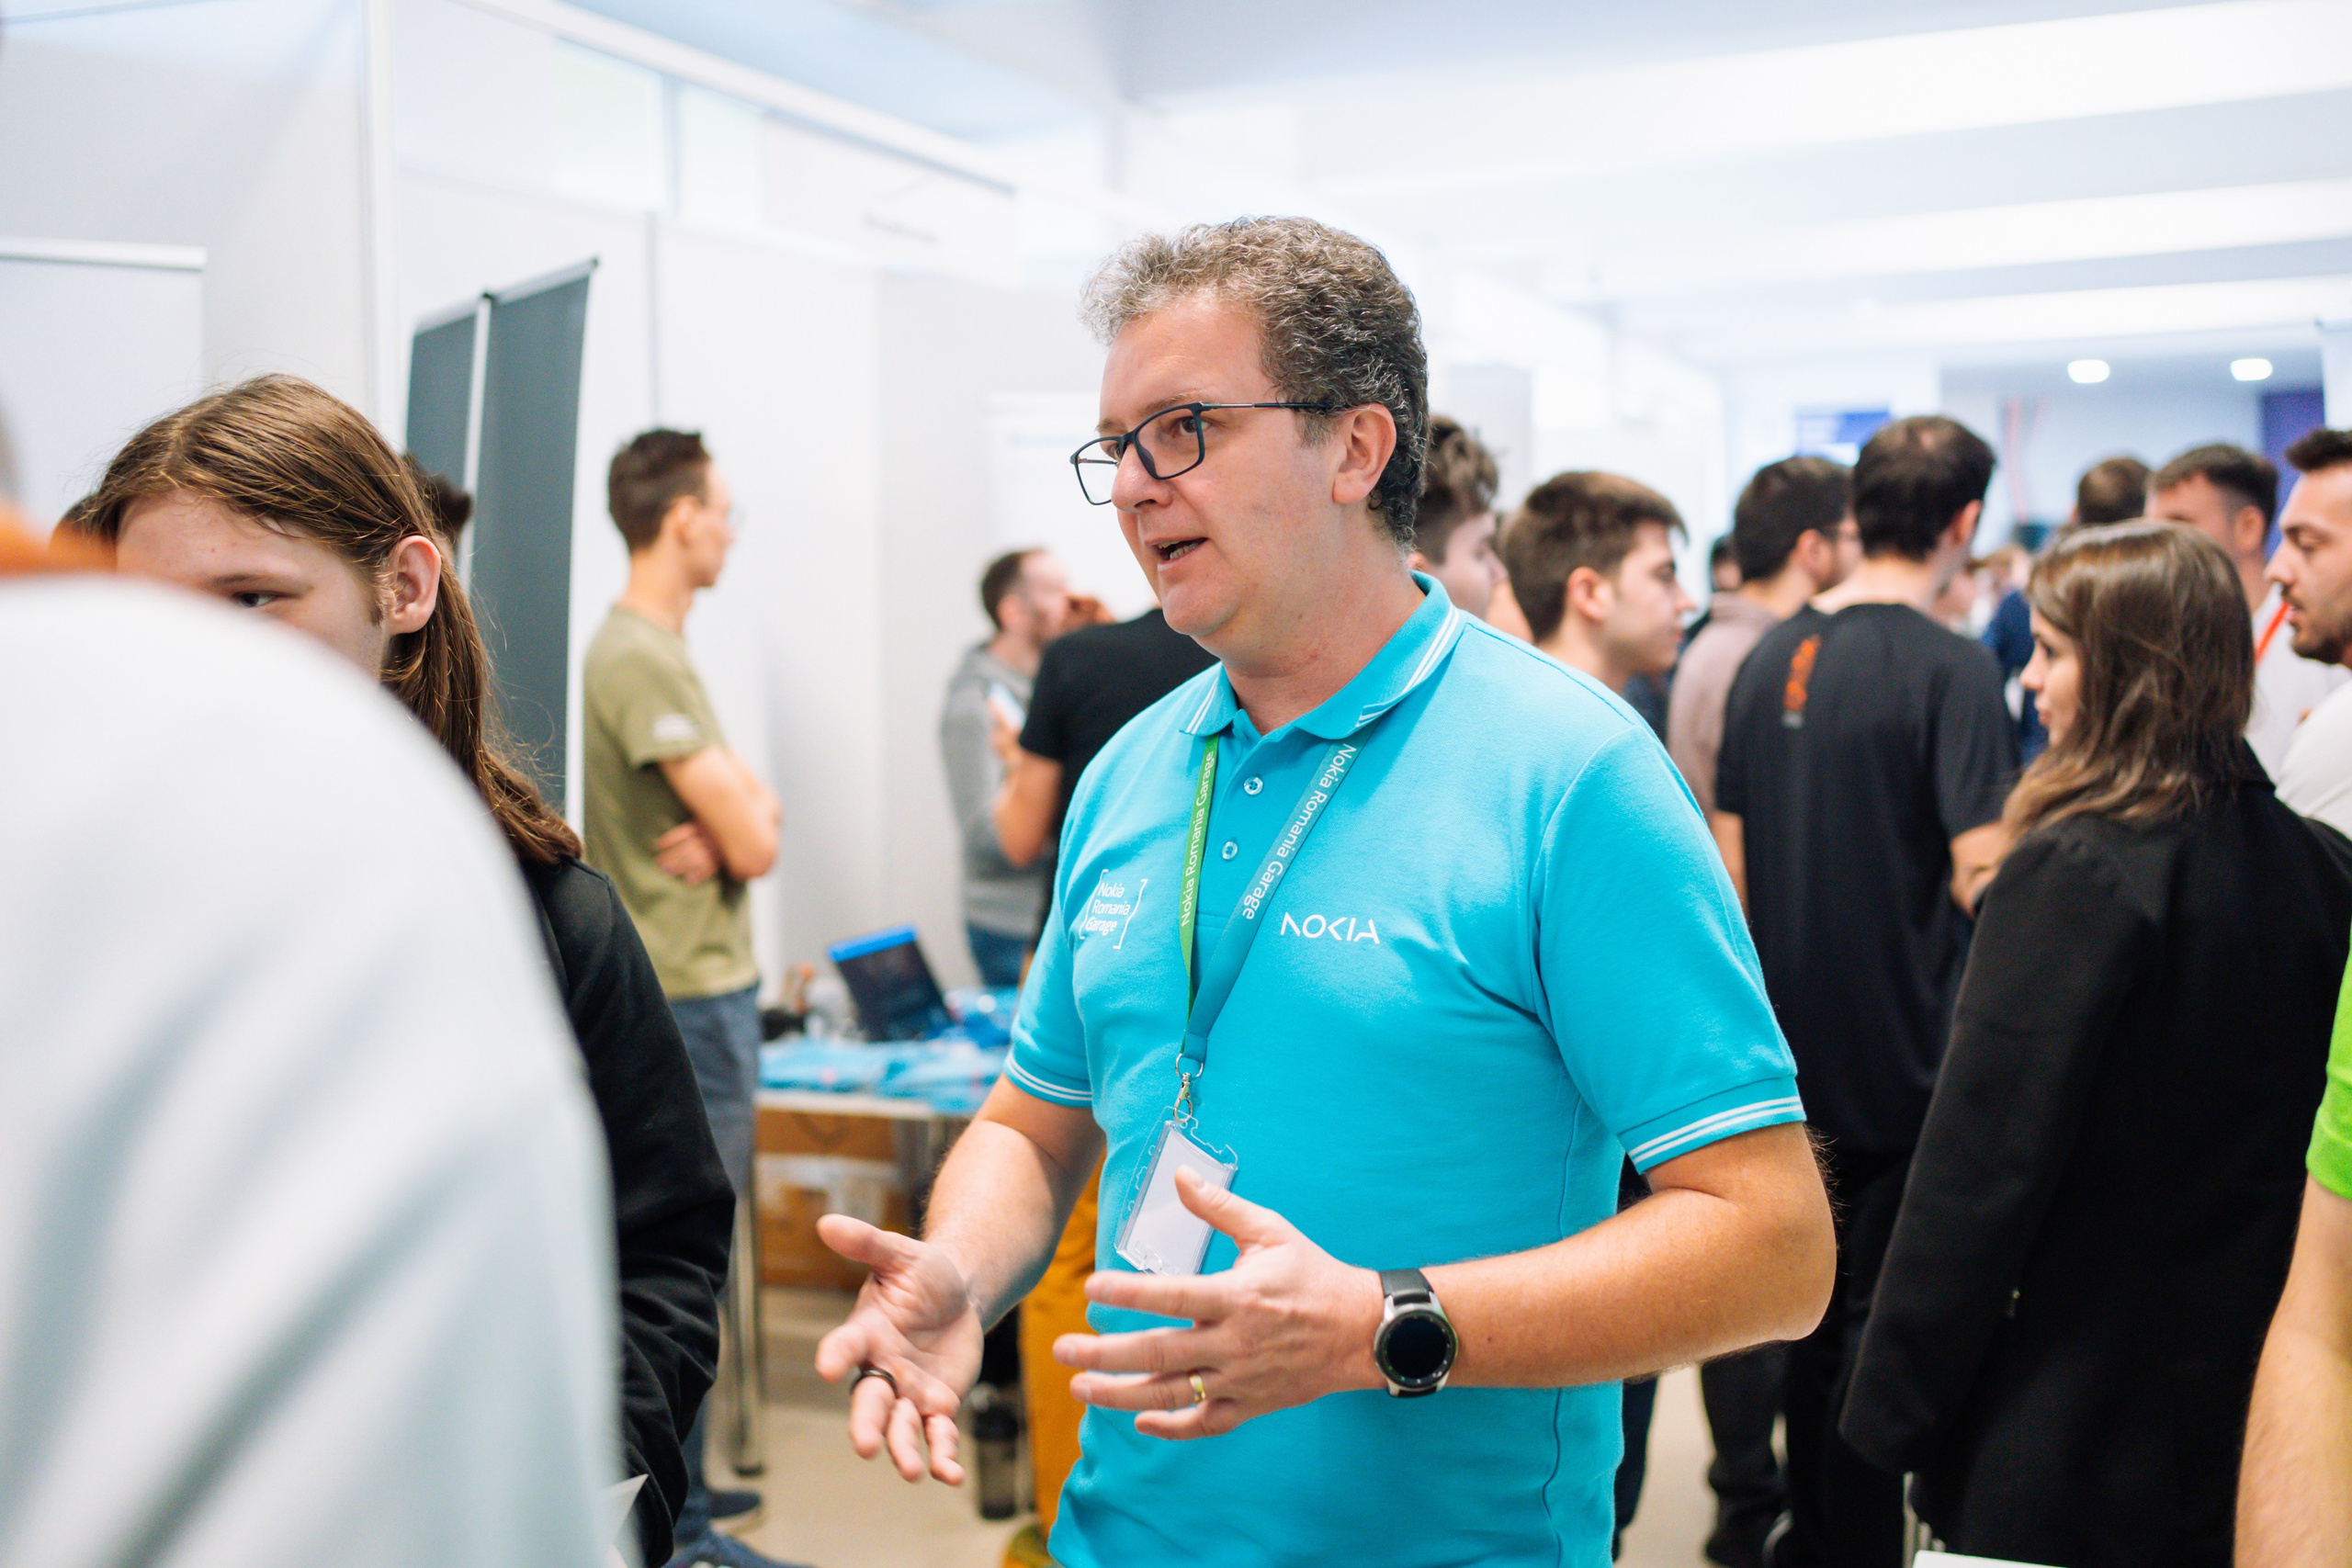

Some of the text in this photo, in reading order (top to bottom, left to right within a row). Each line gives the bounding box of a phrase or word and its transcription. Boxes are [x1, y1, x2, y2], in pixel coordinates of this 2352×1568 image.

[1181, 750, 1216, 928] Nokia Romania Garage
[1242, 742, 1358, 919] Nokia Romania Garage
[1097, 882, 1125, 898] Nokia
[1091, 898, 1131, 916] Romania
[1085, 916, 1118, 936] Garage
[1280, 911, 1381, 945] NOKIA
